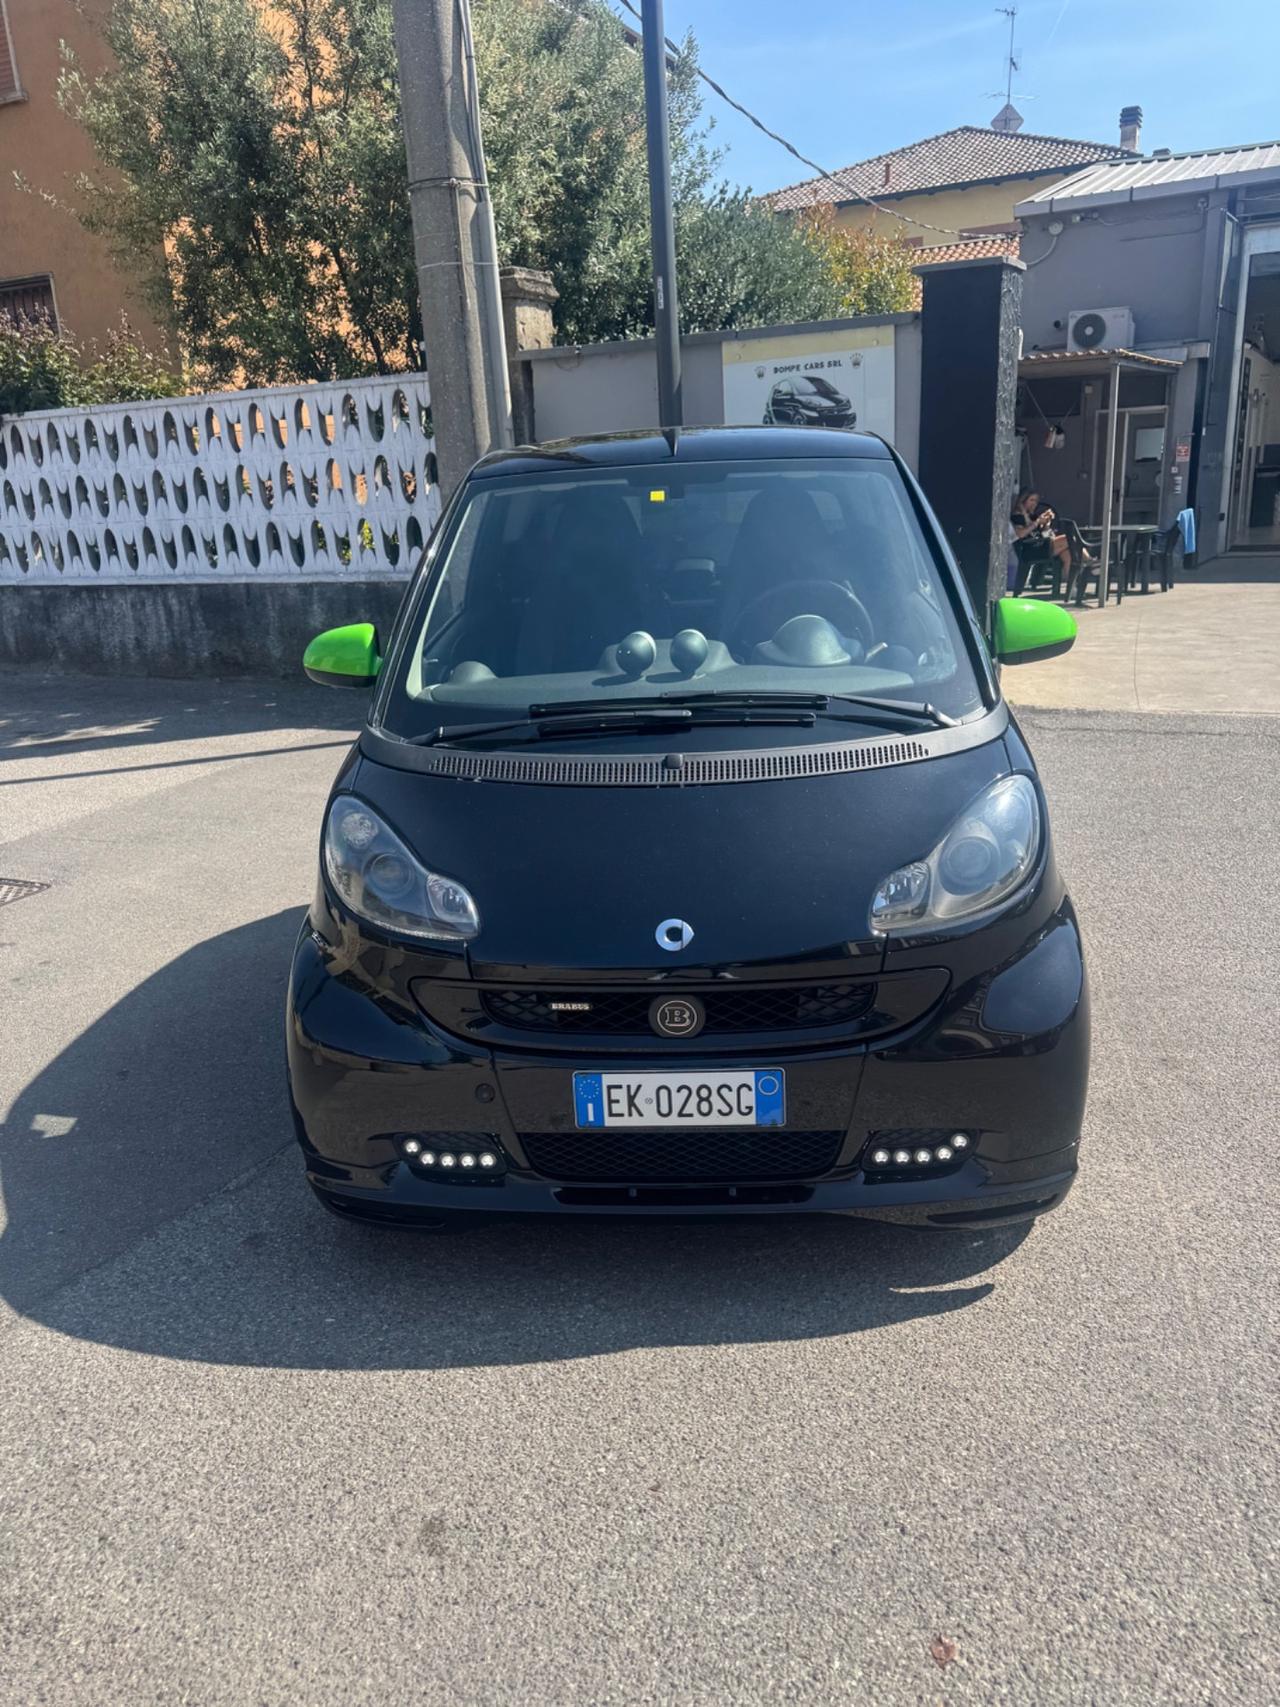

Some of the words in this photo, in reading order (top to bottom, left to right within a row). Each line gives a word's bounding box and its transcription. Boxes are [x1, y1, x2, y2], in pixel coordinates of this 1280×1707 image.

[804, 361, 825, 370] CARS
[827, 360, 842, 368] SRL
[551, 1003, 590, 1011] BRABUS
[665, 1006, 691, 1027] B
